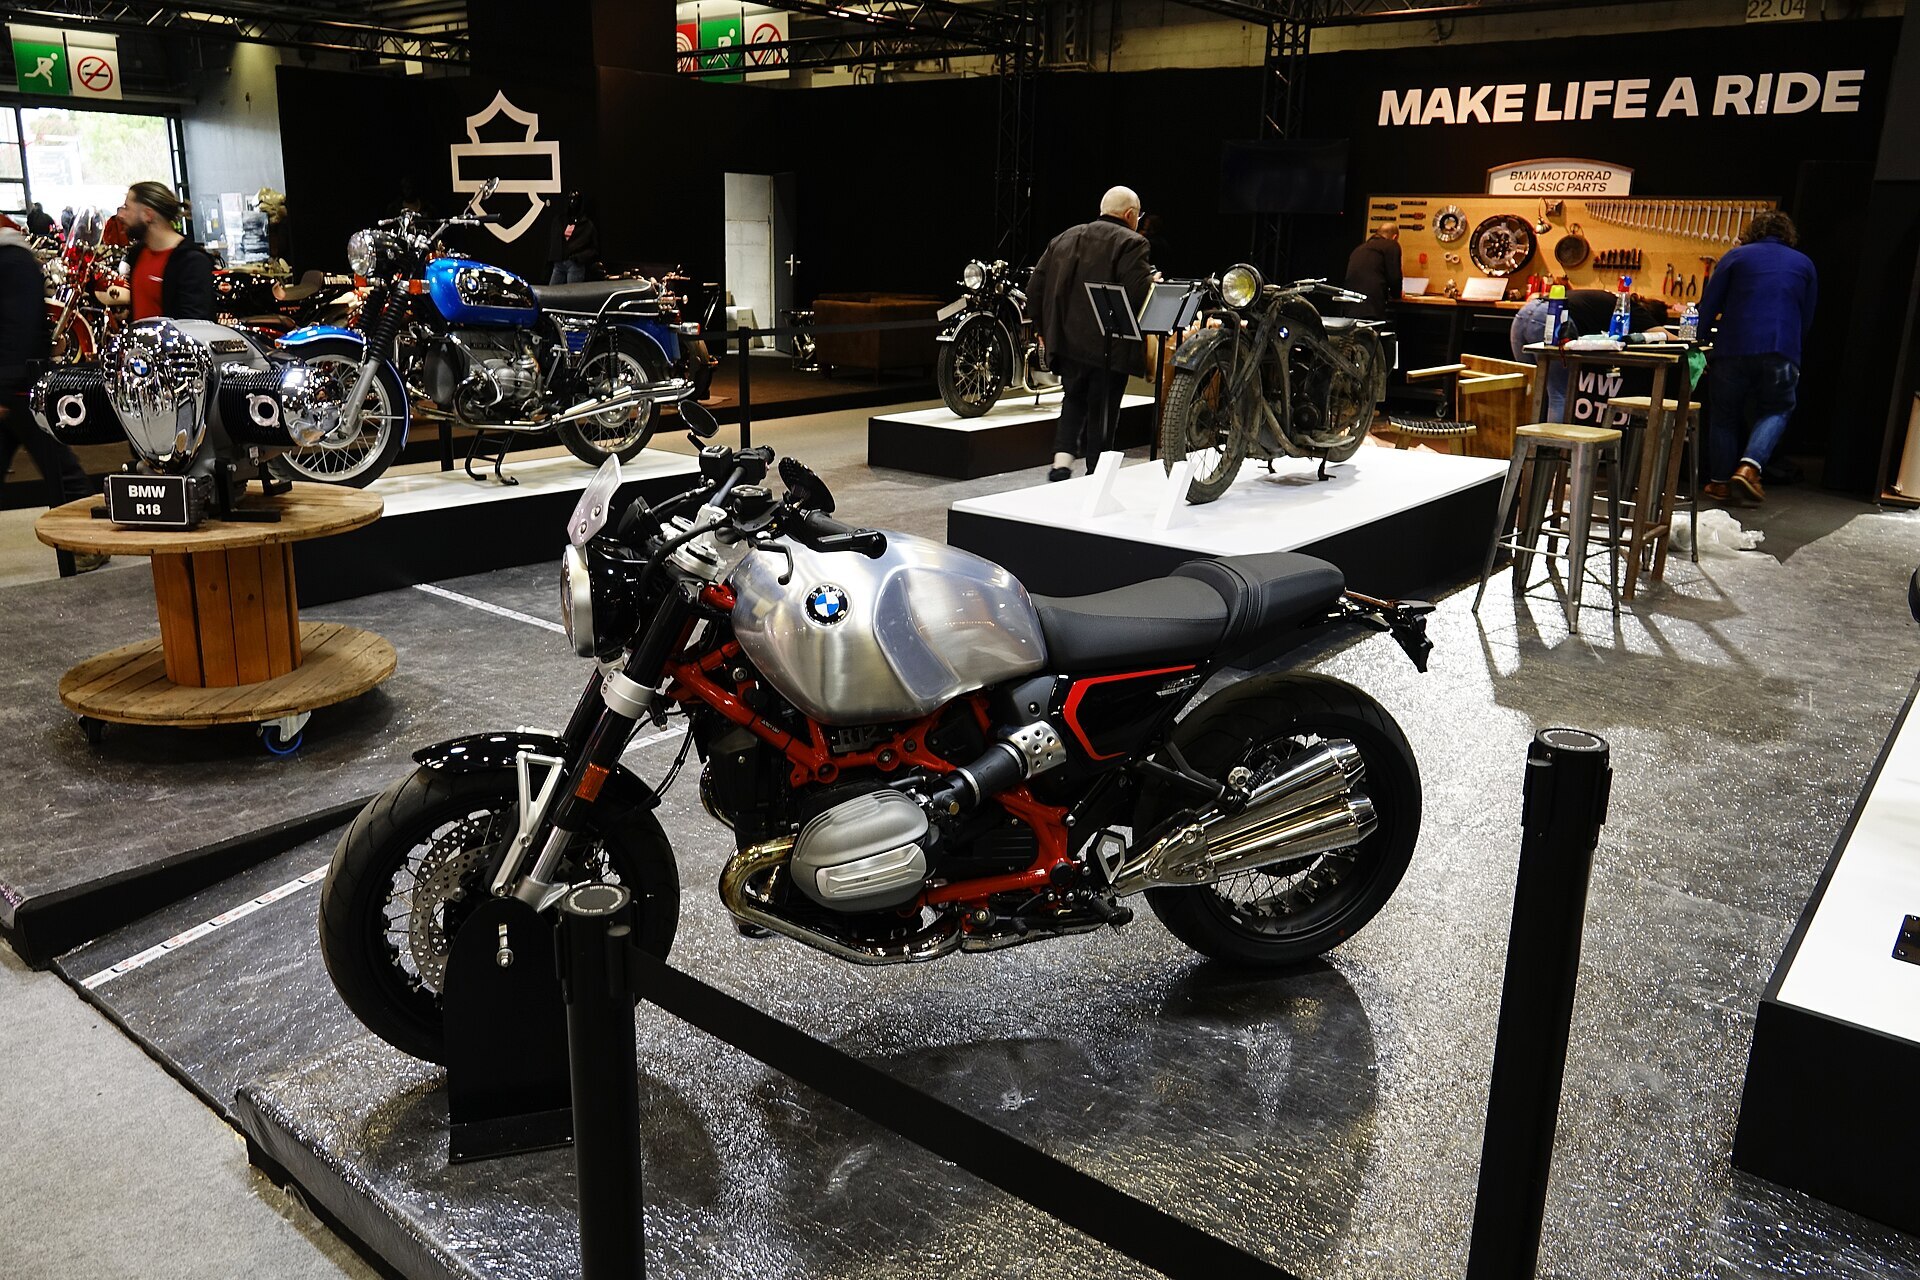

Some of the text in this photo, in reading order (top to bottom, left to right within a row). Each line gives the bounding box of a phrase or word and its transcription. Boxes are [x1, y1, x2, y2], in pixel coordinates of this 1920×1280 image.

[1747, 0, 1805, 18] 22.04
[1378, 69, 1866, 126] MAKE LIFE A RIDE
[1510, 170, 1612, 181] BMW MOTORRAD
[1513, 182, 1607, 192] CLASSIC PARTS
[1578, 370, 1624, 398] MW
[128, 484, 166, 499] BMW
[136, 503, 161, 516] R18
